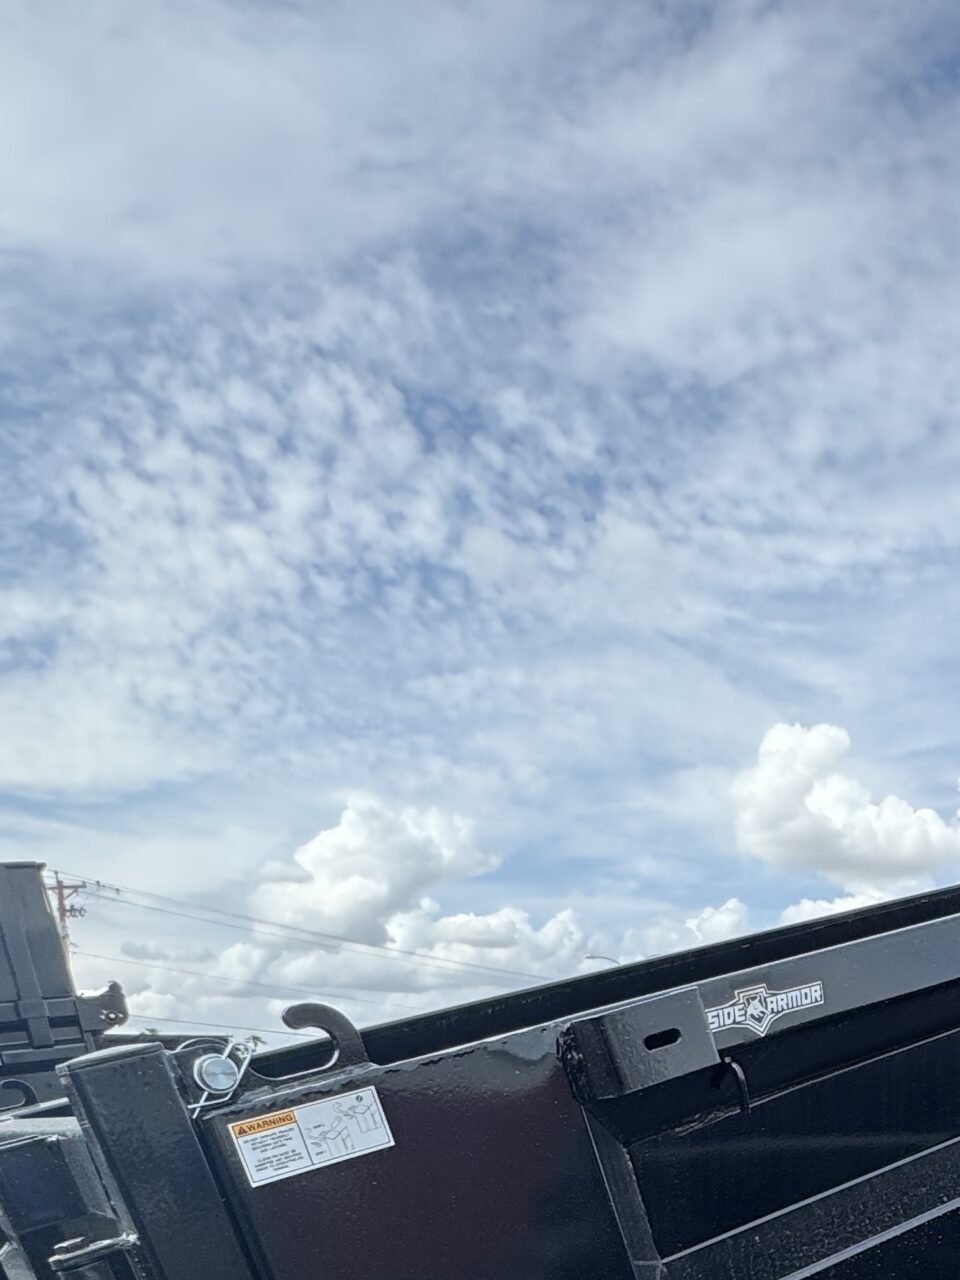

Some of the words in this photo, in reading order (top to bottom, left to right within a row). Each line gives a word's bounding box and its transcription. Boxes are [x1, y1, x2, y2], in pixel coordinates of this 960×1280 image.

[706, 1004, 747, 1029] SIDE
[765, 984, 822, 1013] ARMOR
[246, 1113, 294, 1132] WARNING
